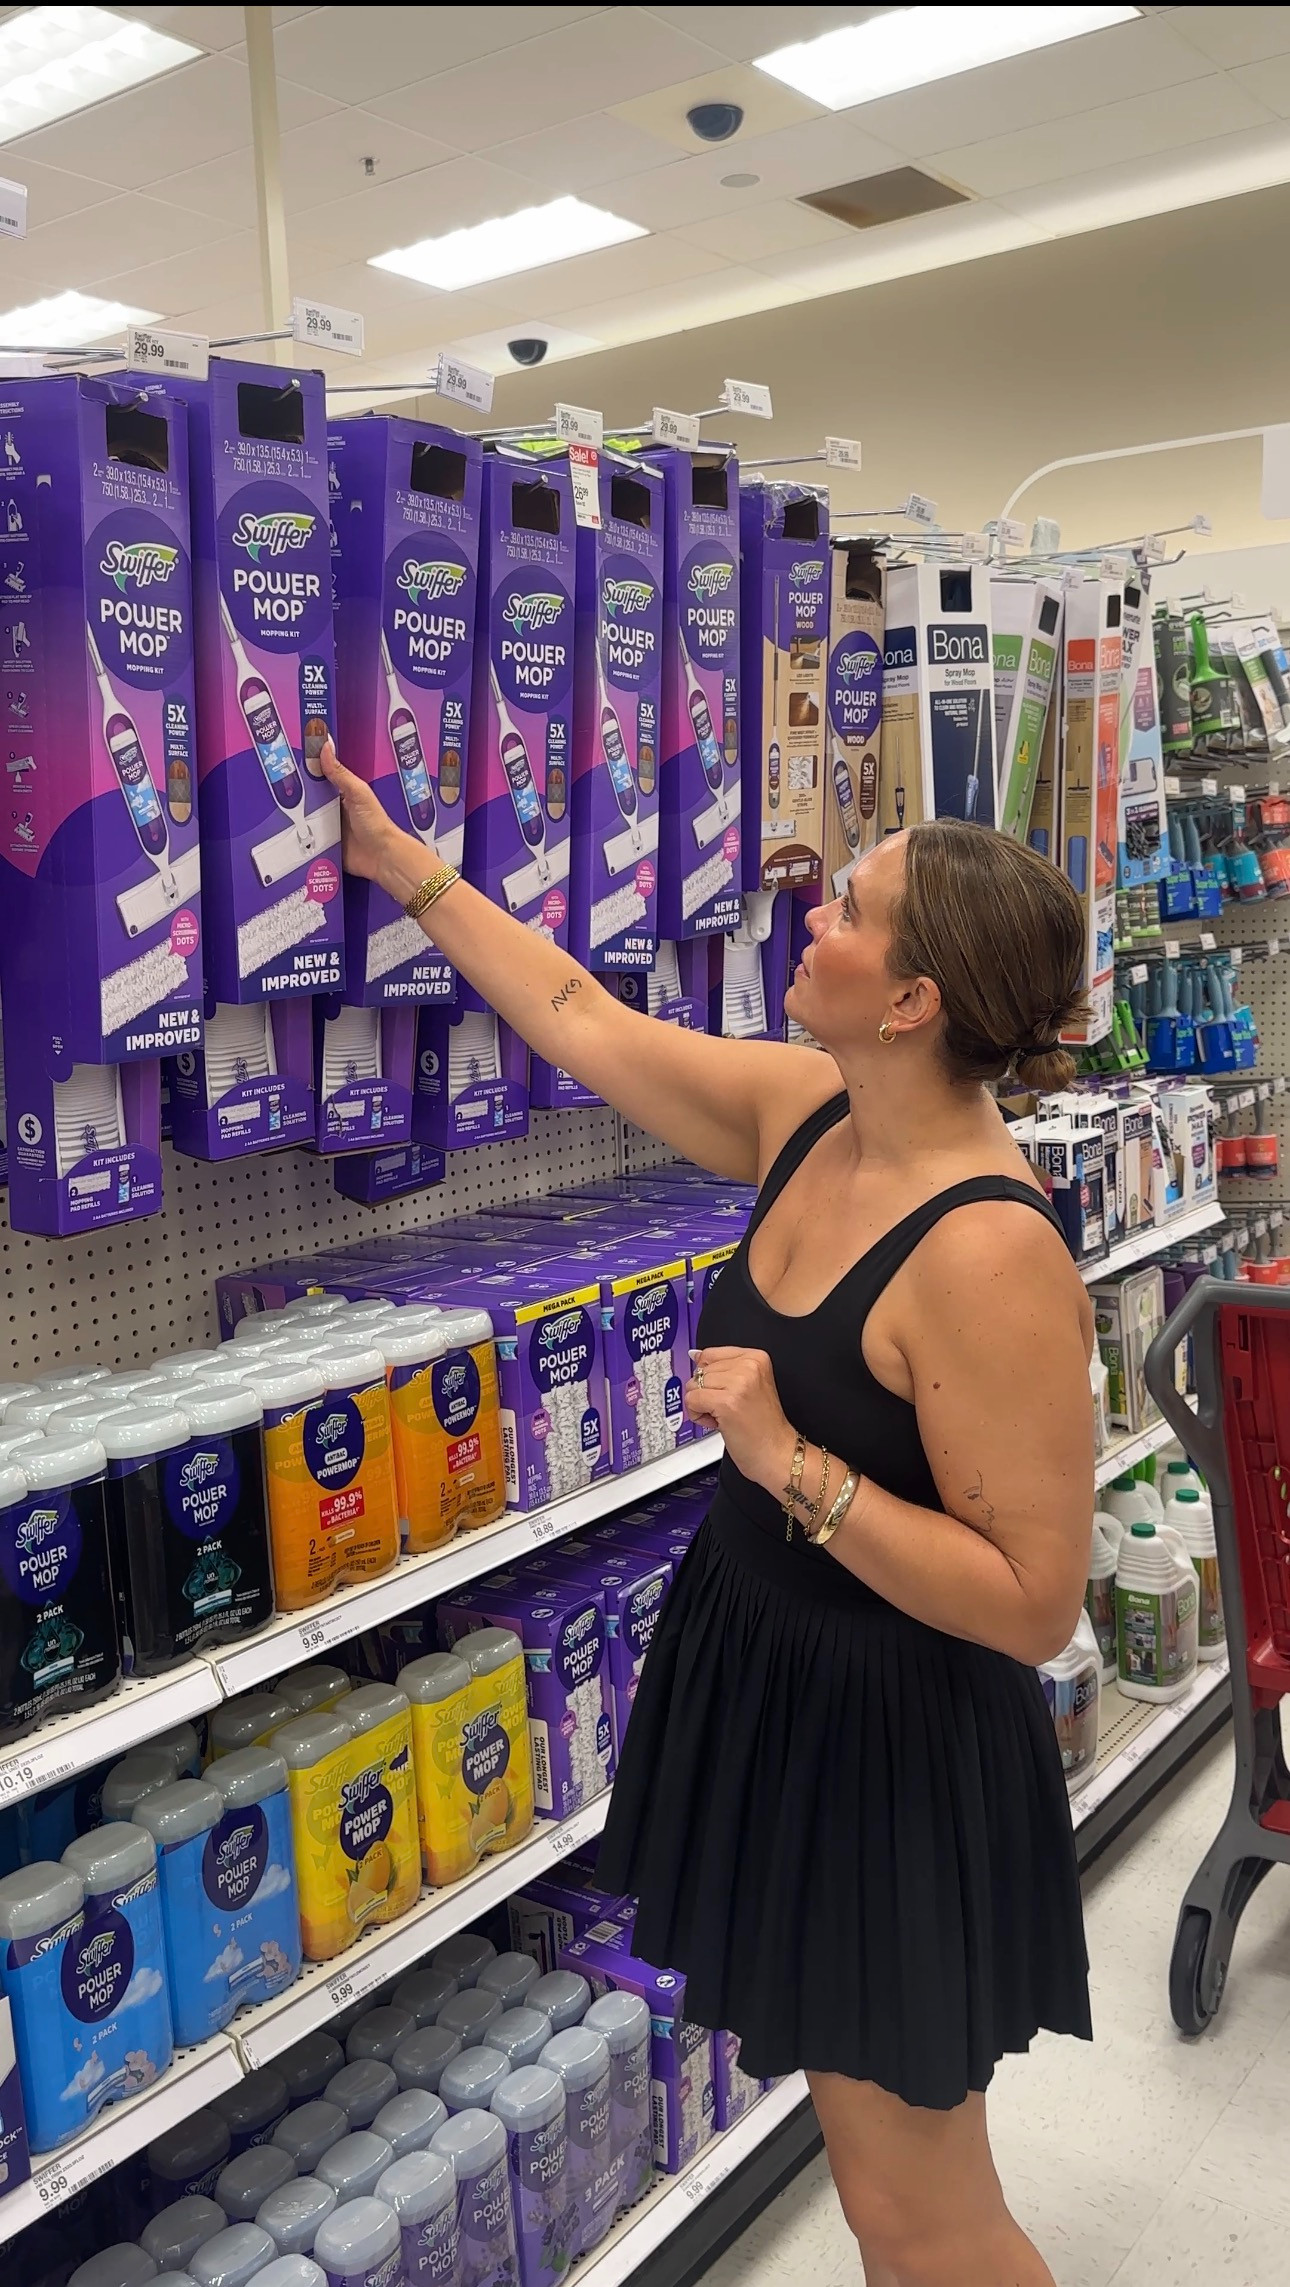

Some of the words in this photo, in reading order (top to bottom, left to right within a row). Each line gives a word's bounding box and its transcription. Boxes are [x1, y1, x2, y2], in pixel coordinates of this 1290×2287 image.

[306, 317, 332, 331] 29.99
[134, 341, 165, 358] 29.99
[447, 375, 467, 390] 29.99
[732, 392, 750, 404] 29.99
[561, 418, 579, 432] 29.99
[660, 422, 678, 434] 29.99
[569, 446, 589, 464] Sale!
[232, 513, 314, 558] Swiffer
[100, 540, 176, 588] Swiffer
[788, 561, 824, 586] Swiffer
[233, 569, 321, 598] POWER
[397, 559, 464, 601] Swiffer
[688, 563, 732, 598] Swiffer
[602, 578, 652, 615] Swiffer
[788, 591, 824, 605] POWER
[100, 598, 182, 633] POWER
[254, 597, 304, 622] MOP
[503, 593, 562, 630] Swiffer
[687, 608, 736, 627] POWER
[795, 605, 816, 618] MOP
[261, 629, 289, 638] MOPPING
[394, 609, 466, 641] POWER
[795, 621, 814, 629] WOOD
[119, 629, 168, 658] MOP
[601, 620, 655, 651] POWER
[698, 629, 727, 647] MOP
[932, 629, 984, 661] Bona
[408, 636, 452, 661] MOP
[501, 641, 566, 666] POWER
[609, 645, 644, 668] MOP
[1100, 645, 1120, 670] Bona
[126, 663, 152, 674] MOPPING
[304, 665, 325, 683] 5X
[412, 665, 436, 675] MOPPING
[836, 652, 876, 681] Swiffer
[944, 668, 962, 678] Spray
[963, 667, 976, 678] Mop
[1028, 648, 1052, 680] Bona
[1068, 660, 1094, 671] Bona
[515, 664, 553, 687] MOP
[724, 679, 737, 692] 5X
[519, 691, 541, 700] MOPPING
[834, 689, 877, 708] POWER
[166, 704, 187, 723] 5X
[445, 701, 463, 719] 5X
[640, 703, 654, 719] 5X
[843, 707, 869, 724] MOP
[165, 722, 189, 731] CLEANING
[256, 720, 278, 737] POWER
[261, 729, 275, 740] MOP
[549, 722, 565, 739] 5X
[846, 735, 865, 744] WOOD
[122, 760, 144, 777] POWER
[128, 769, 141, 781] MOP
[862, 763, 875, 776] 5X
[312, 883, 334, 893] DOTS
[714, 900, 734, 914] NEW
[695, 911, 740, 931] IMPROVED
[176, 936, 195, 946] DOTS
[625, 938, 645, 950] NEW
[646, 938, 653, 950] &
[294, 954, 327, 971] NEW
[329, 951, 340, 966] &
[604, 951, 653, 965] IMPROVED
[261, 968, 341, 992] IMPROVED
[413, 967, 440, 981] NEW
[441, 965, 452, 978] &
[383, 980, 452, 997] IMPROVED
[159, 1010, 189, 1028] NEW
[191, 1009, 200, 1024] &
[126, 1027, 201, 1051] IMPROVED
[242, 1088, 253, 1098] KIT
[253, 1083, 286, 1096] INCLUDES
[1125, 1116, 1145, 1134] Bona
[93, 1158, 104, 1167] KIT
[105, 1152, 136, 1165] INCLUDES
[1082, 1140, 1103, 1160] Bona
[131, 1183, 155, 1193] CLEANING
[131, 1188, 155, 1199] SOLUTION
[70, 1196, 94, 1206] MOPPING
[636, 1277, 651, 1286] MEGA
[651, 1271, 664, 1282] PACK
[543, 1300, 560, 1312] MEGA
[560, 1297, 576, 1308] PACK
[632, 1285, 668, 1317] Swiffer
[538, 1311, 581, 1344] Swiffer
[631, 1316, 671, 1342] POWER
[640, 1334, 664, 1354] MOP
[539, 1345, 587, 1372] POWER
[550, 1363, 579, 1384] MOP
[666, 1385, 680, 1403] 5X
[316, 1414, 348, 1444] Swiffer
[583, 1417, 599, 1436] 5X
[326, 1451, 346, 1463] ANTIBAC
[180, 1453, 218, 1491] Swiffer
[317, 1458, 358, 1480] POWERMOP
[527, 1465, 535, 1477] 11
[182, 1485, 227, 1511] POWER
[321, 1507, 334, 1518] KILLS
[333, 1492, 363, 1511] 99.9%
[194, 1504, 219, 1524] MOP
[15, 1510, 58, 1547] Swiffer
[197, 1546, 202, 1556] 2
[203, 1540, 222, 1553] PACK
[19, 1545, 68, 1577] POWER
[32, 1566, 59, 1589] MOP
[36, 1613, 42, 1624] 2
[43, 1604, 64, 1621] PACK
[298, 1620, 321, 1635] SWIFFER
[302, 1631, 325, 1649] 9.99
[563, 1637, 600, 1670] POWER
[571, 1655, 594, 1680] MOP
[460, 1708, 500, 1747] Swiffer
[466, 1738, 505, 1771] POWER
[534, 1737, 542, 1772] LASTING
[473, 1755, 499, 1782] MOP
[540, 1747, 549, 1793] LONGEST
[338, 1767, 384, 1811] Swiffer
[344, 1798, 388, 1836] POWER
[352, 1817, 381, 1847] MOP
[552, 1833, 575, 1853] 14.99
[364, 1850, 382, 1866] PACK
[218, 1856, 258, 1889] POWER
[227, 1876, 250, 1899] MOP
[236, 1913, 253, 1929] PACK
[76, 1932, 115, 1974] Swiffer
[78, 1962, 122, 2000] POWER
[89, 1985, 114, 2010] MOP
[331, 1984, 354, 2005] 9.99
[33, 2163, 61, 2185] SWIFFER
[541, 2155, 566, 2183] MOP
[584, 2187, 592, 2203] 3
[594, 2153, 625, 2190] PACK
[39, 2176, 68, 2202] 9.99
[686, 2181, 704, 2200] 9.99
[432, 2248, 458, 2278] MOP
